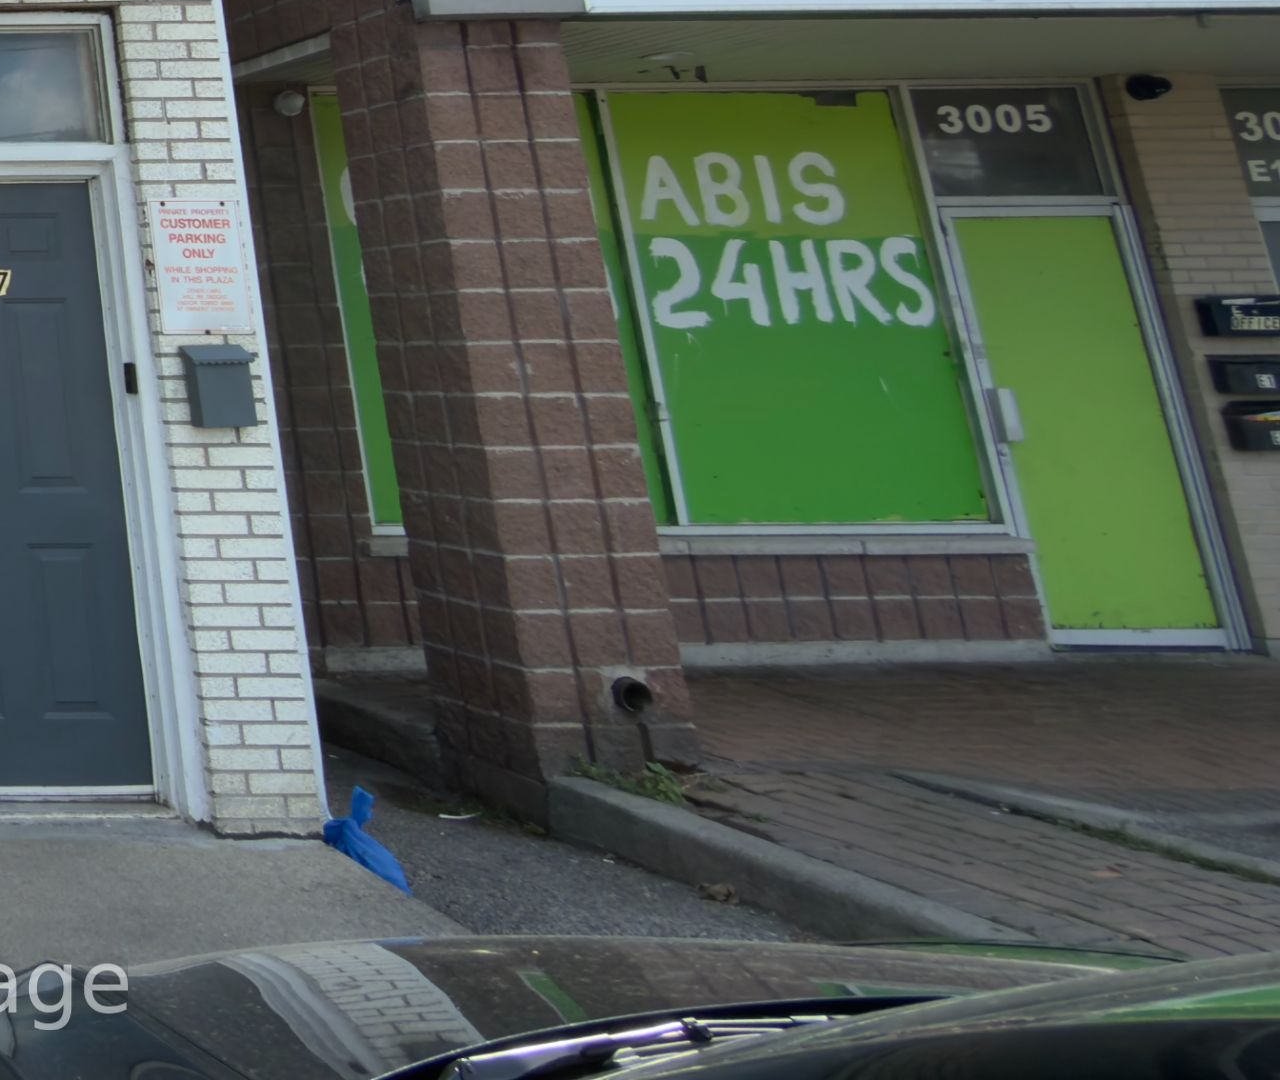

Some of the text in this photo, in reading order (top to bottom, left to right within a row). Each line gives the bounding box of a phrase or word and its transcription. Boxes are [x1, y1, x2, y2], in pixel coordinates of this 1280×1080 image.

[936, 103, 1054, 135] 3005
[640, 150, 847, 227] ABIS
[160, 218, 231, 229] CUSTOMER
[168, 233, 226, 244] PARKING
[182, 248, 215, 258] ONLY
[164, 266, 238, 274] WHILE SHOPPING
[206, 276, 234, 284] PLAZA
[648, 233, 937, 329] 24HRS
[1231, 316, 1280, 330] OFFICE
